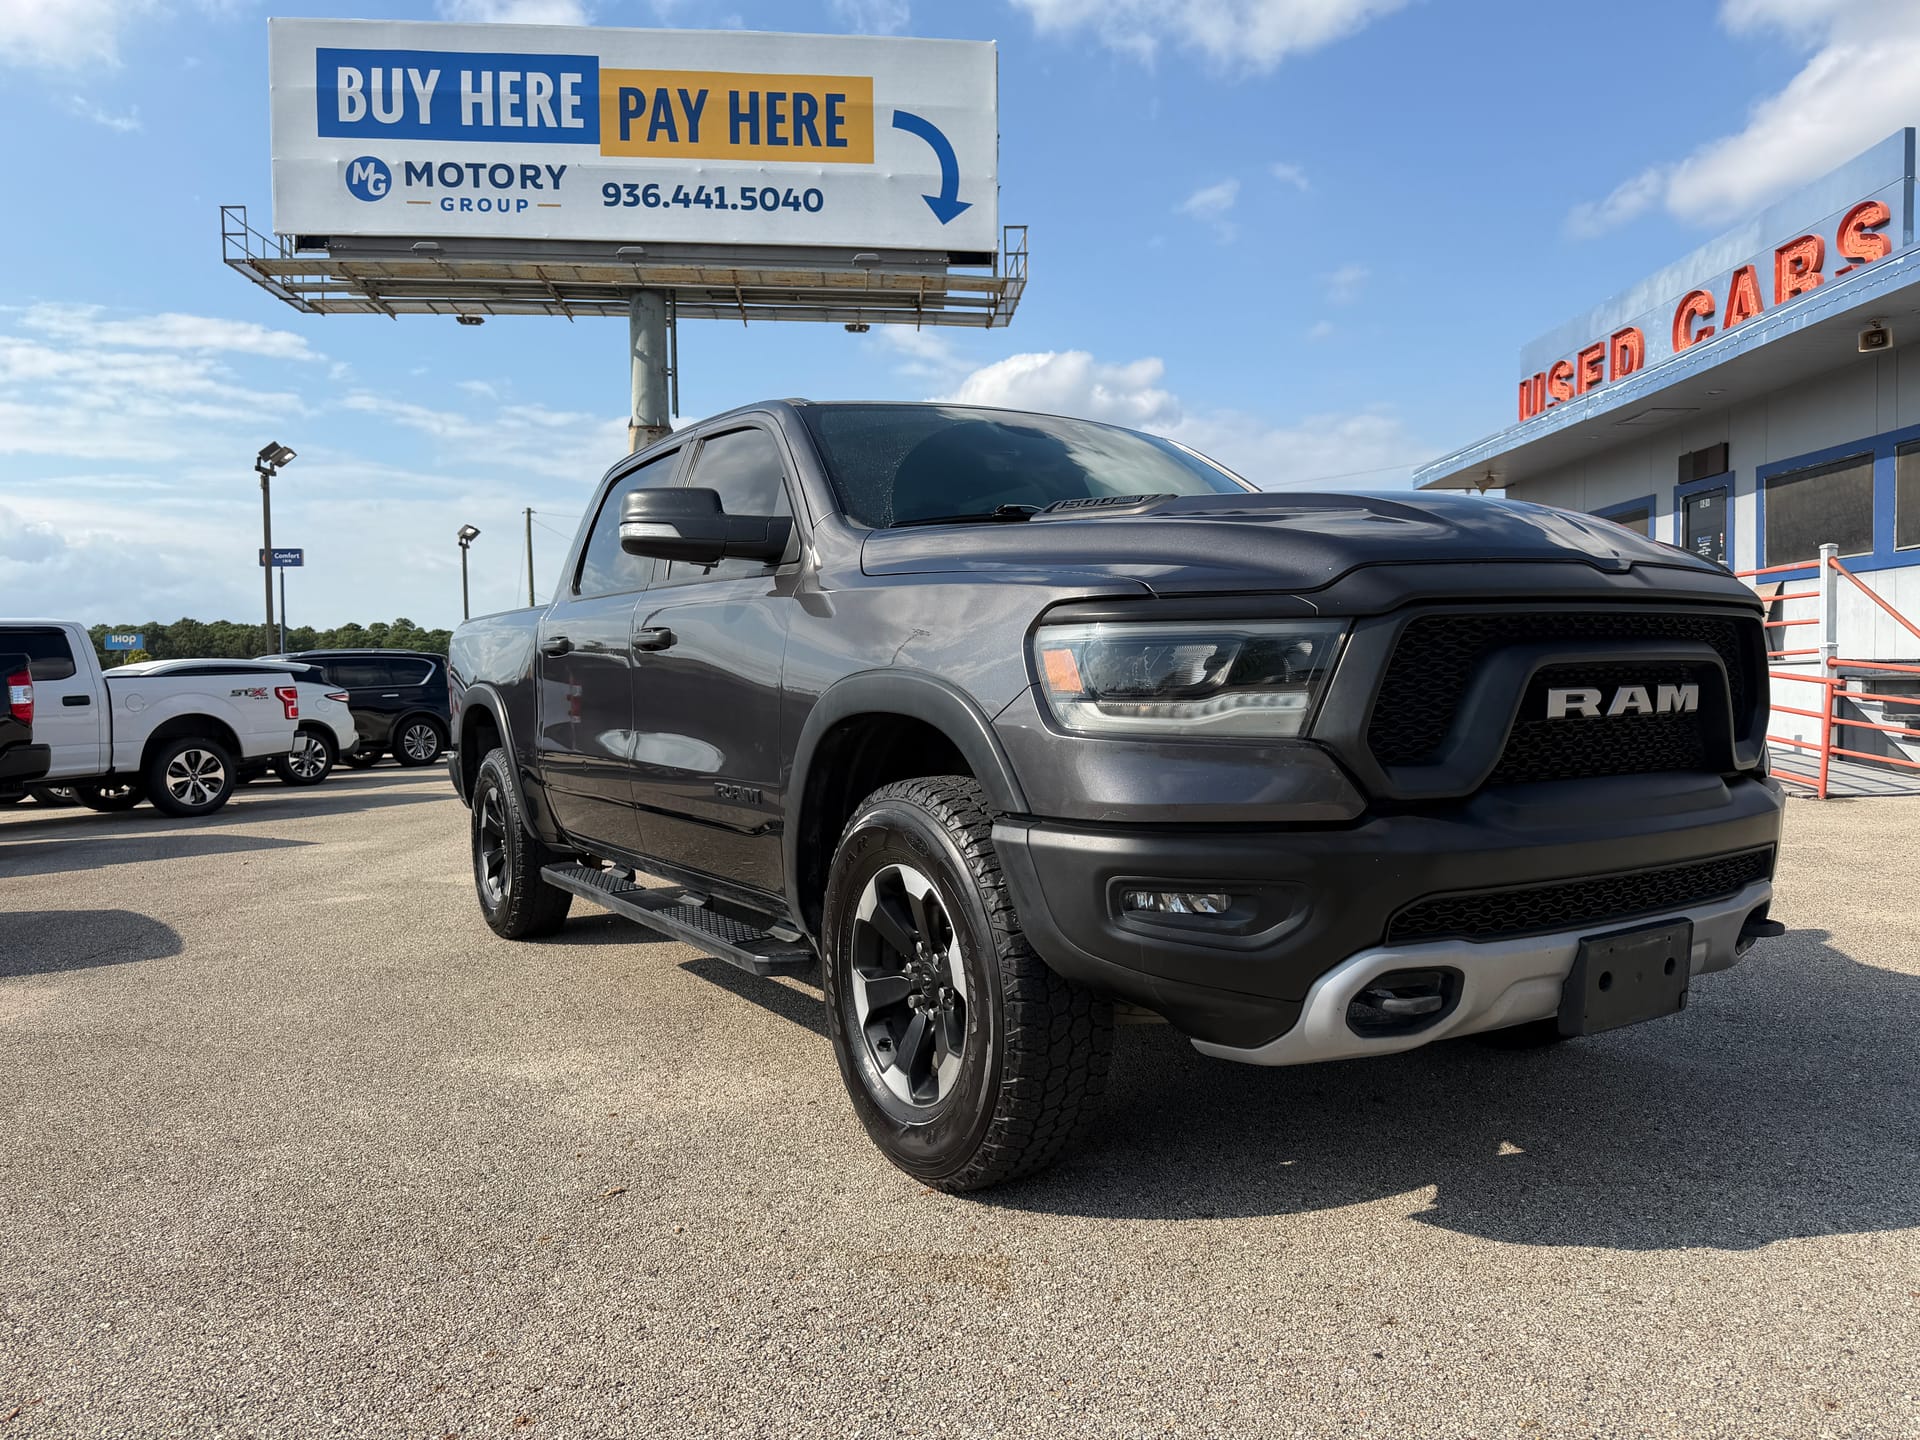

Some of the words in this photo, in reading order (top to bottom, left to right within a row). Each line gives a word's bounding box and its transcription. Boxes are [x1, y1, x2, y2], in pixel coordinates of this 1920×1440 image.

[337, 66, 441, 125] BUY
[460, 70, 585, 129] HERE
[618, 86, 709, 143] PAY
[728, 90, 848, 148] HERE
[351, 161, 387, 196] MG
[404, 161, 568, 190] MOTORY
[440, 197, 529, 213] GROUP
[601, 182, 824, 213] 936.441.5040
[1518, 326, 1646, 423] USED
[1672, 200, 1893, 354] CARS
[274, 552, 300, 560] Comfort
[1546, 682, 1699, 719] RAM
[714, 782, 763, 805] RAM
